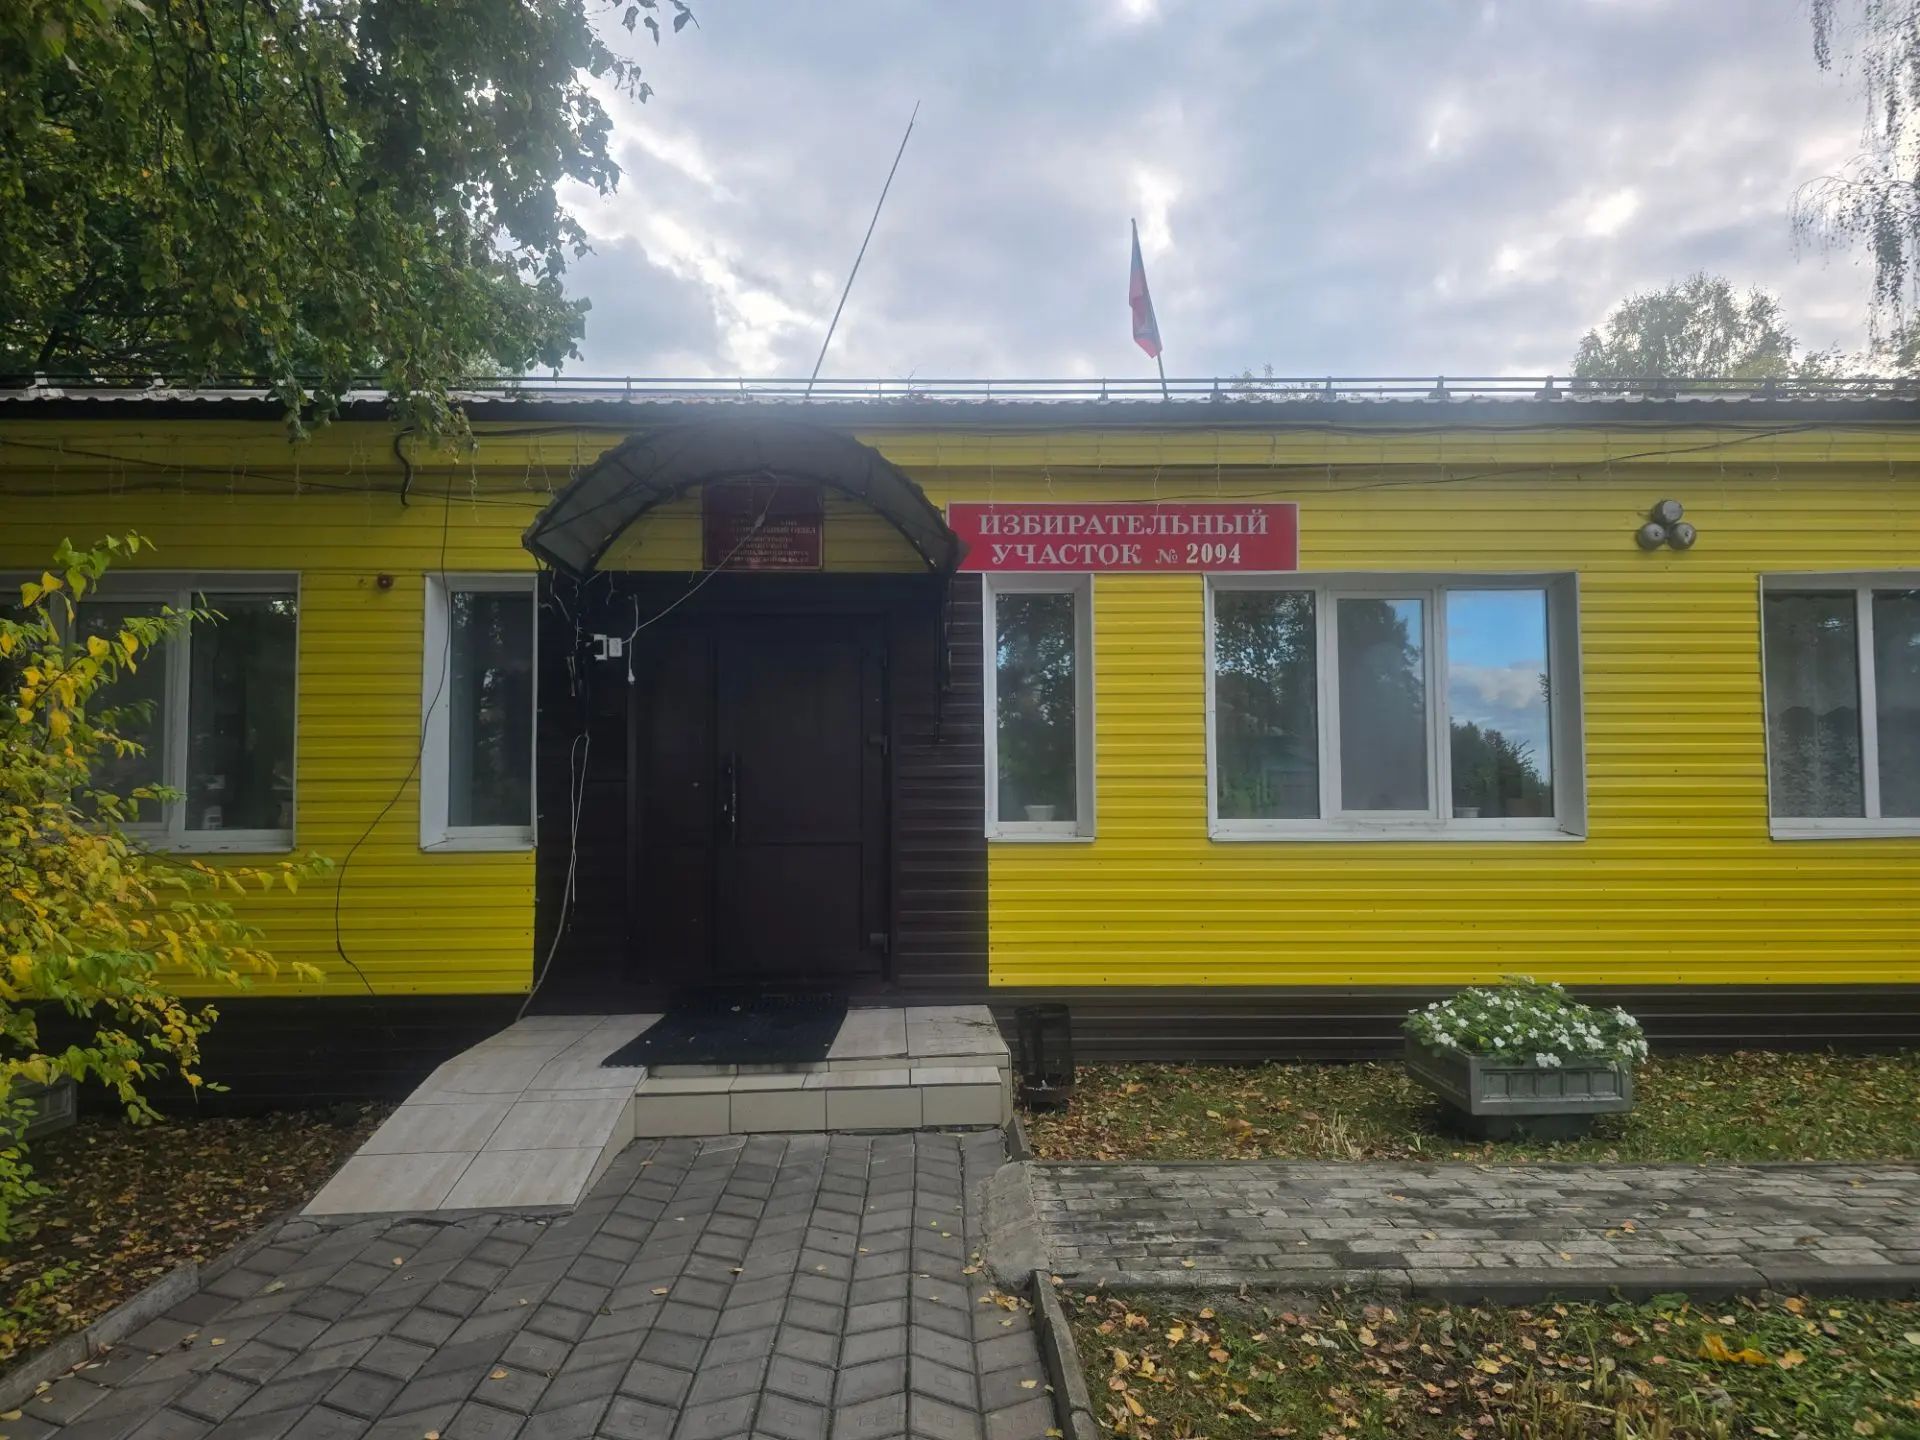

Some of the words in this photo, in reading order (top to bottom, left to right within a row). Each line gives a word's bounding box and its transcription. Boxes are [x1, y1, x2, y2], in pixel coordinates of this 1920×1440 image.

[979, 508, 1267, 535] ИЗБИРАТЕЛЬНЫЙ
[992, 543, 1141, 565] УЧАСТОК
[1155, 548, 1179, 564] №
[1186, 543, 1240, 564] 2094
